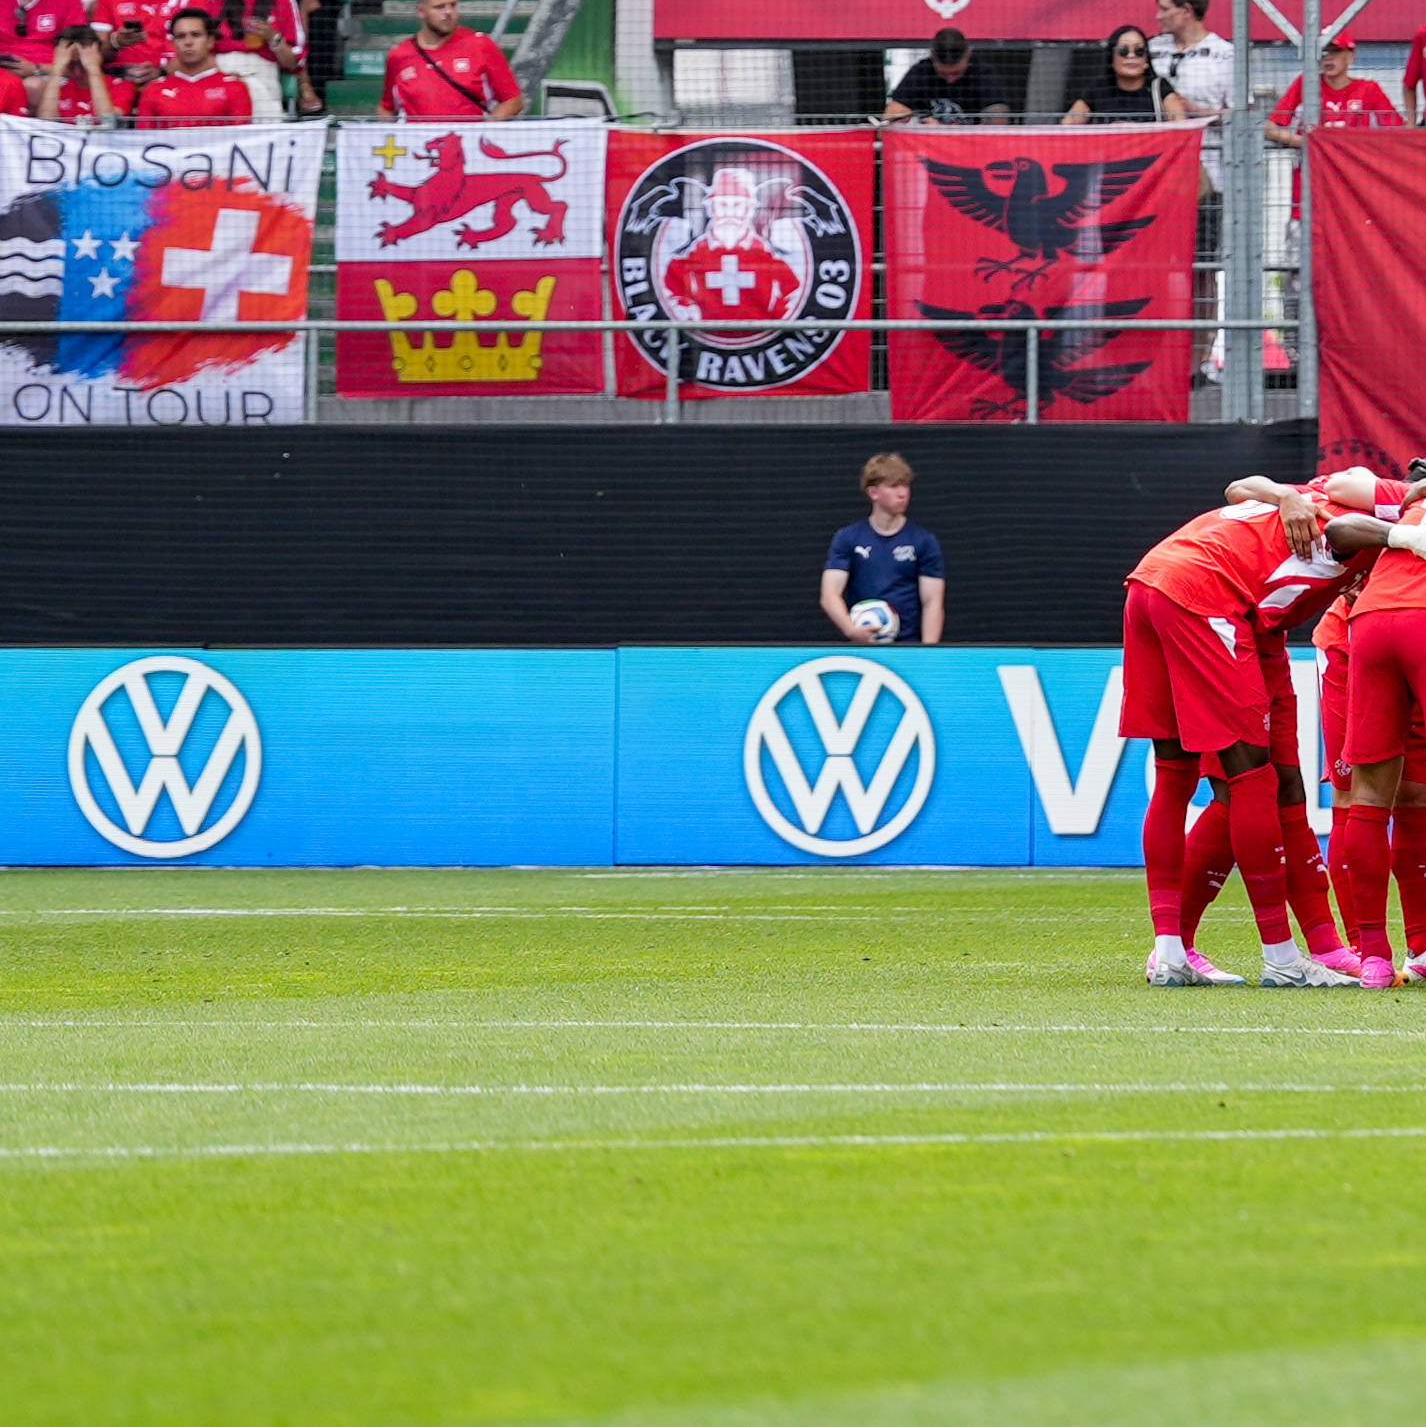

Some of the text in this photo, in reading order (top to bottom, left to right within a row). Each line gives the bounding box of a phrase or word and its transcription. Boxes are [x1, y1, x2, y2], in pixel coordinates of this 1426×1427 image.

[815, 259, 850, 309] 03
[13, 383, 274, 425] ON TOUR
